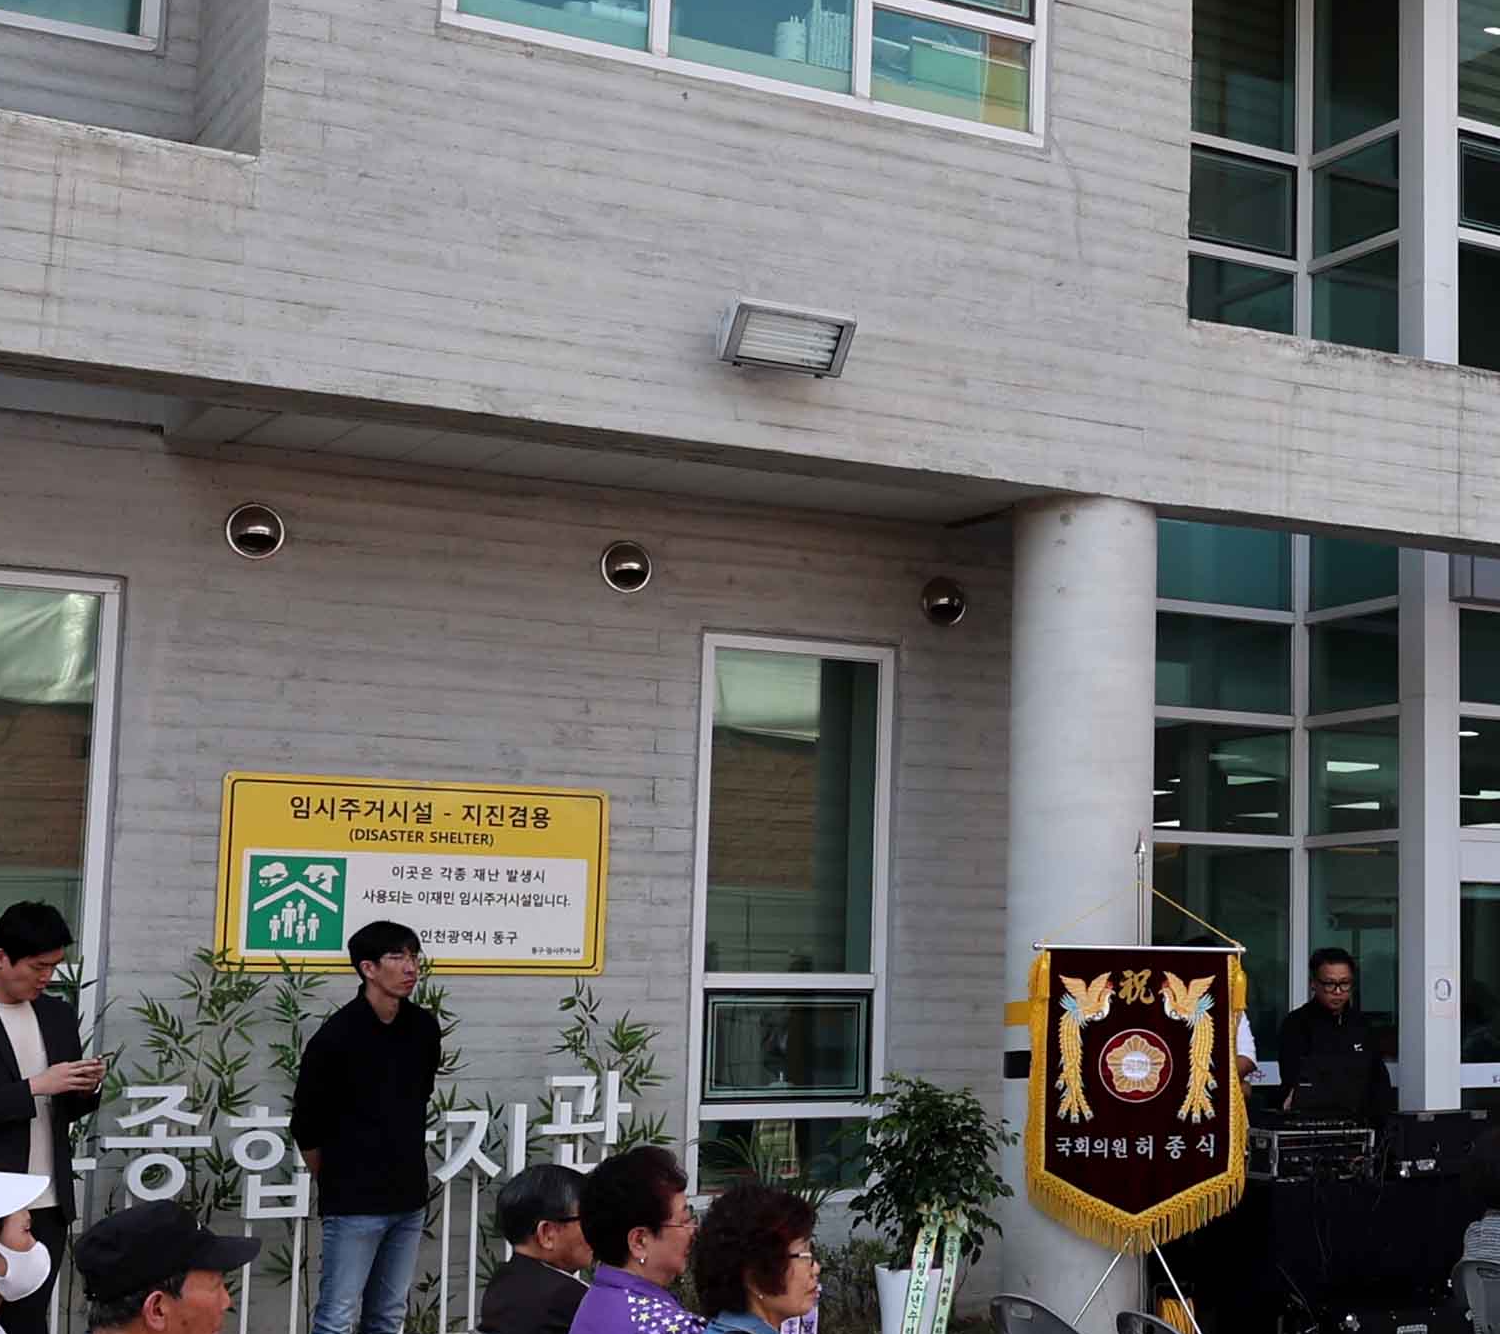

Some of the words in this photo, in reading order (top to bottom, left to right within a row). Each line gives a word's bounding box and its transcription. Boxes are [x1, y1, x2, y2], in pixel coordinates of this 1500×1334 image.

[289, 795, 433, 825] 임시주거시설
[461, 803, 552, 830] 지진겸용
[348, 827, 425, 845] (DISASTER
[430, 830, 495, 847] SHELTER)
[391, 865, 434, 881] 이곳은
[440, 866, 467, 882] 각종
[473, 867, 499, 882] 재난
[506, 867, 546, 884] 발생시
[362, 888, 414, 905] 사용되는
[418, 889, 456, 906] 이재민
[459, 890, 572, 909] 임시주거시설입니다.
[419, 928, 487, 946] 인천광역시
[492, 930, 519, 946] 동구
[1118, 969, 1156, 1005] 祝
[1055, 1135, 1128, 1160] 국회의원
[1134, 1135, 1155, 1160] 허
[1164, 1135, 1187, 1160] 종
[1195, 1133, 1216, 1159] 식
